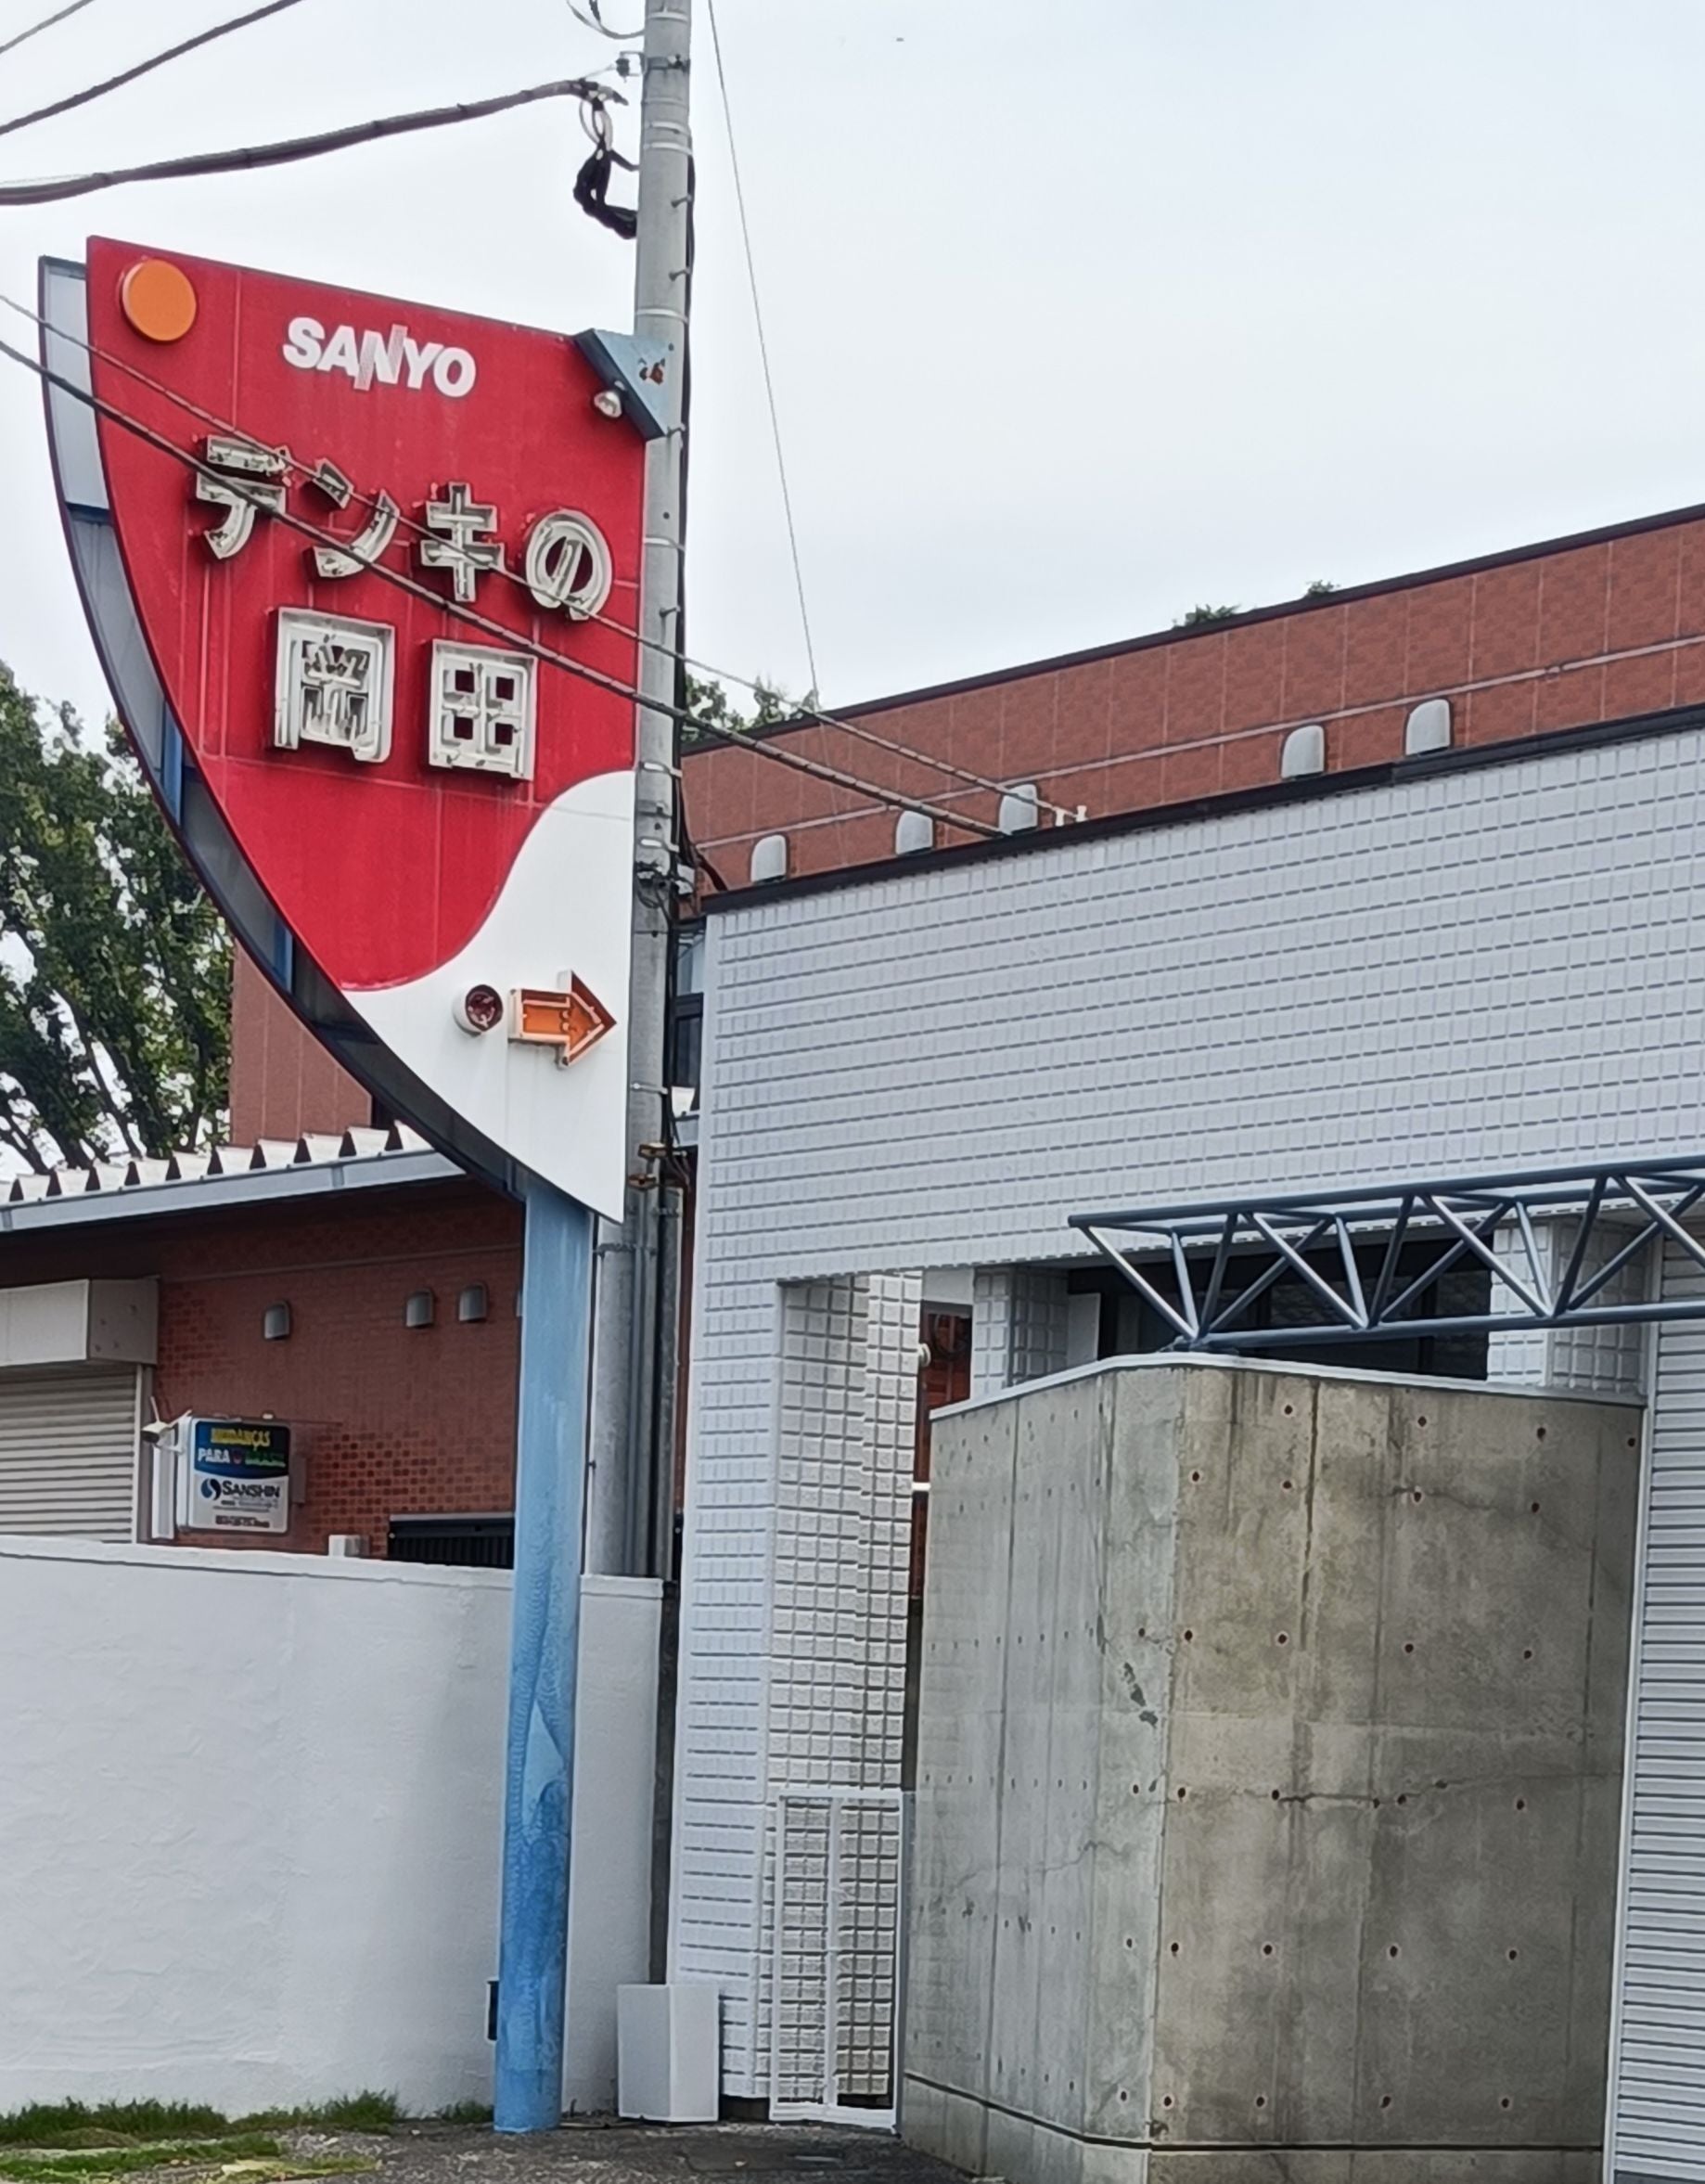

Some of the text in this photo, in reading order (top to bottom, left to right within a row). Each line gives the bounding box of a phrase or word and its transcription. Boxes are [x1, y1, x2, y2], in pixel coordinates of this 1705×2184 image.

[283, 316, 476, 397] SANYO
[194, 434, 612, 621] デンキの
[275, 608, 537, 780] 岡田
[198, 1448, 230, 1464] PARA
[222, 1481, 280, 1497] SANSHIN
